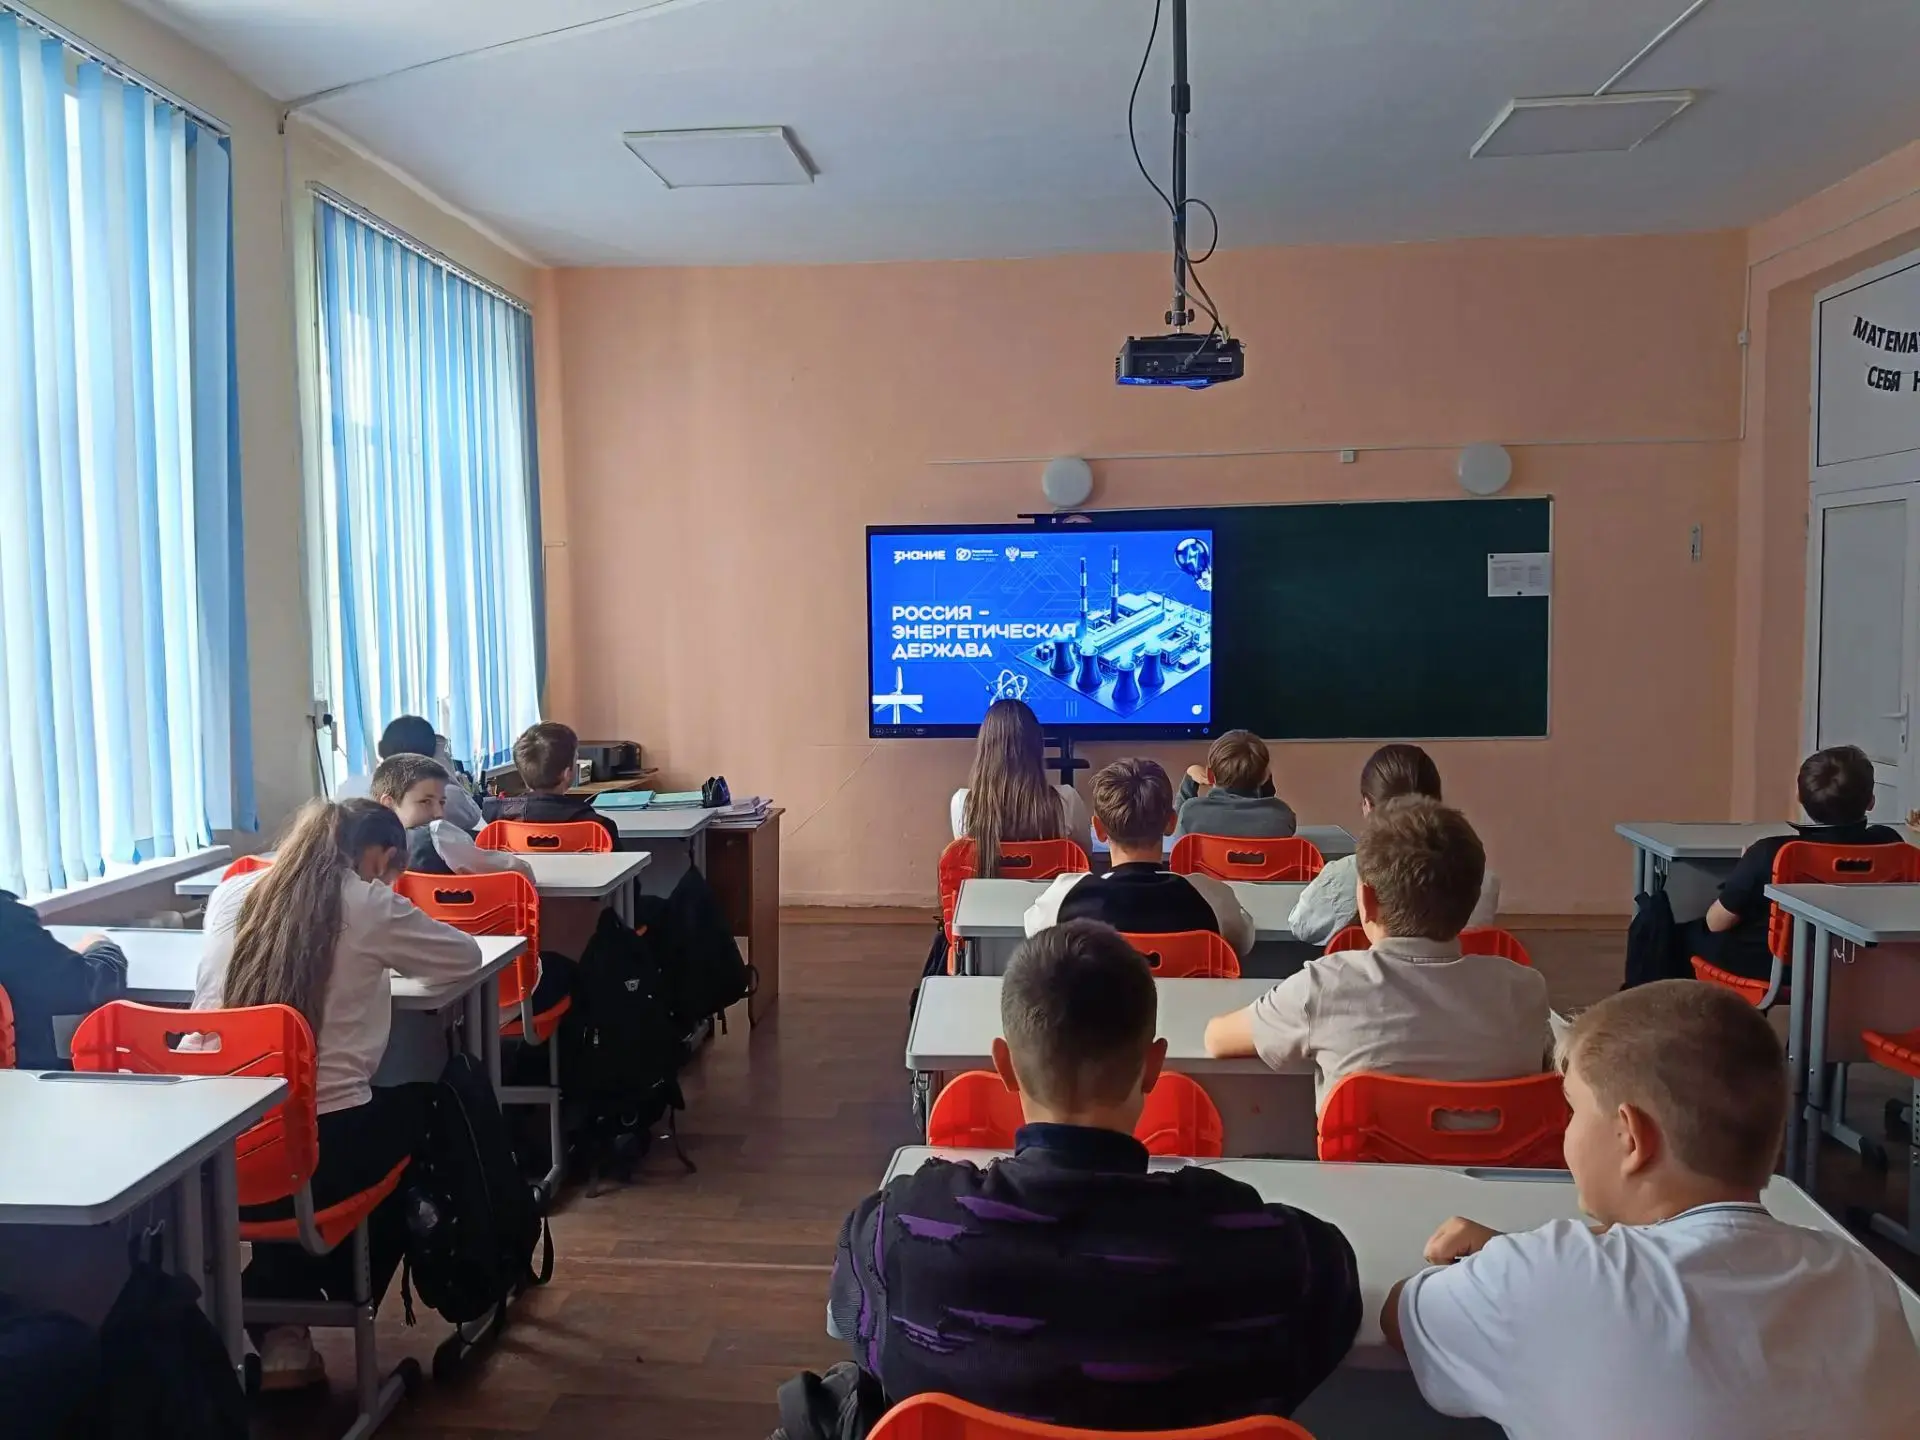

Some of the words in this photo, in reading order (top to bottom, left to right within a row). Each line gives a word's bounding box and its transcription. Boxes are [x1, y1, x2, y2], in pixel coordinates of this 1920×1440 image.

[1853, 317, 1920, 353] МАТЕМА
[1867, 366, 1900, 392] СЕБЯ
[892, 605, 972, 621] РОССИЯ
[891, 623, 1077, 639] ЭНЕРГЕТИЧЕСКАЯ
[891, 642, 993, 660] ДЕРЖАВА
